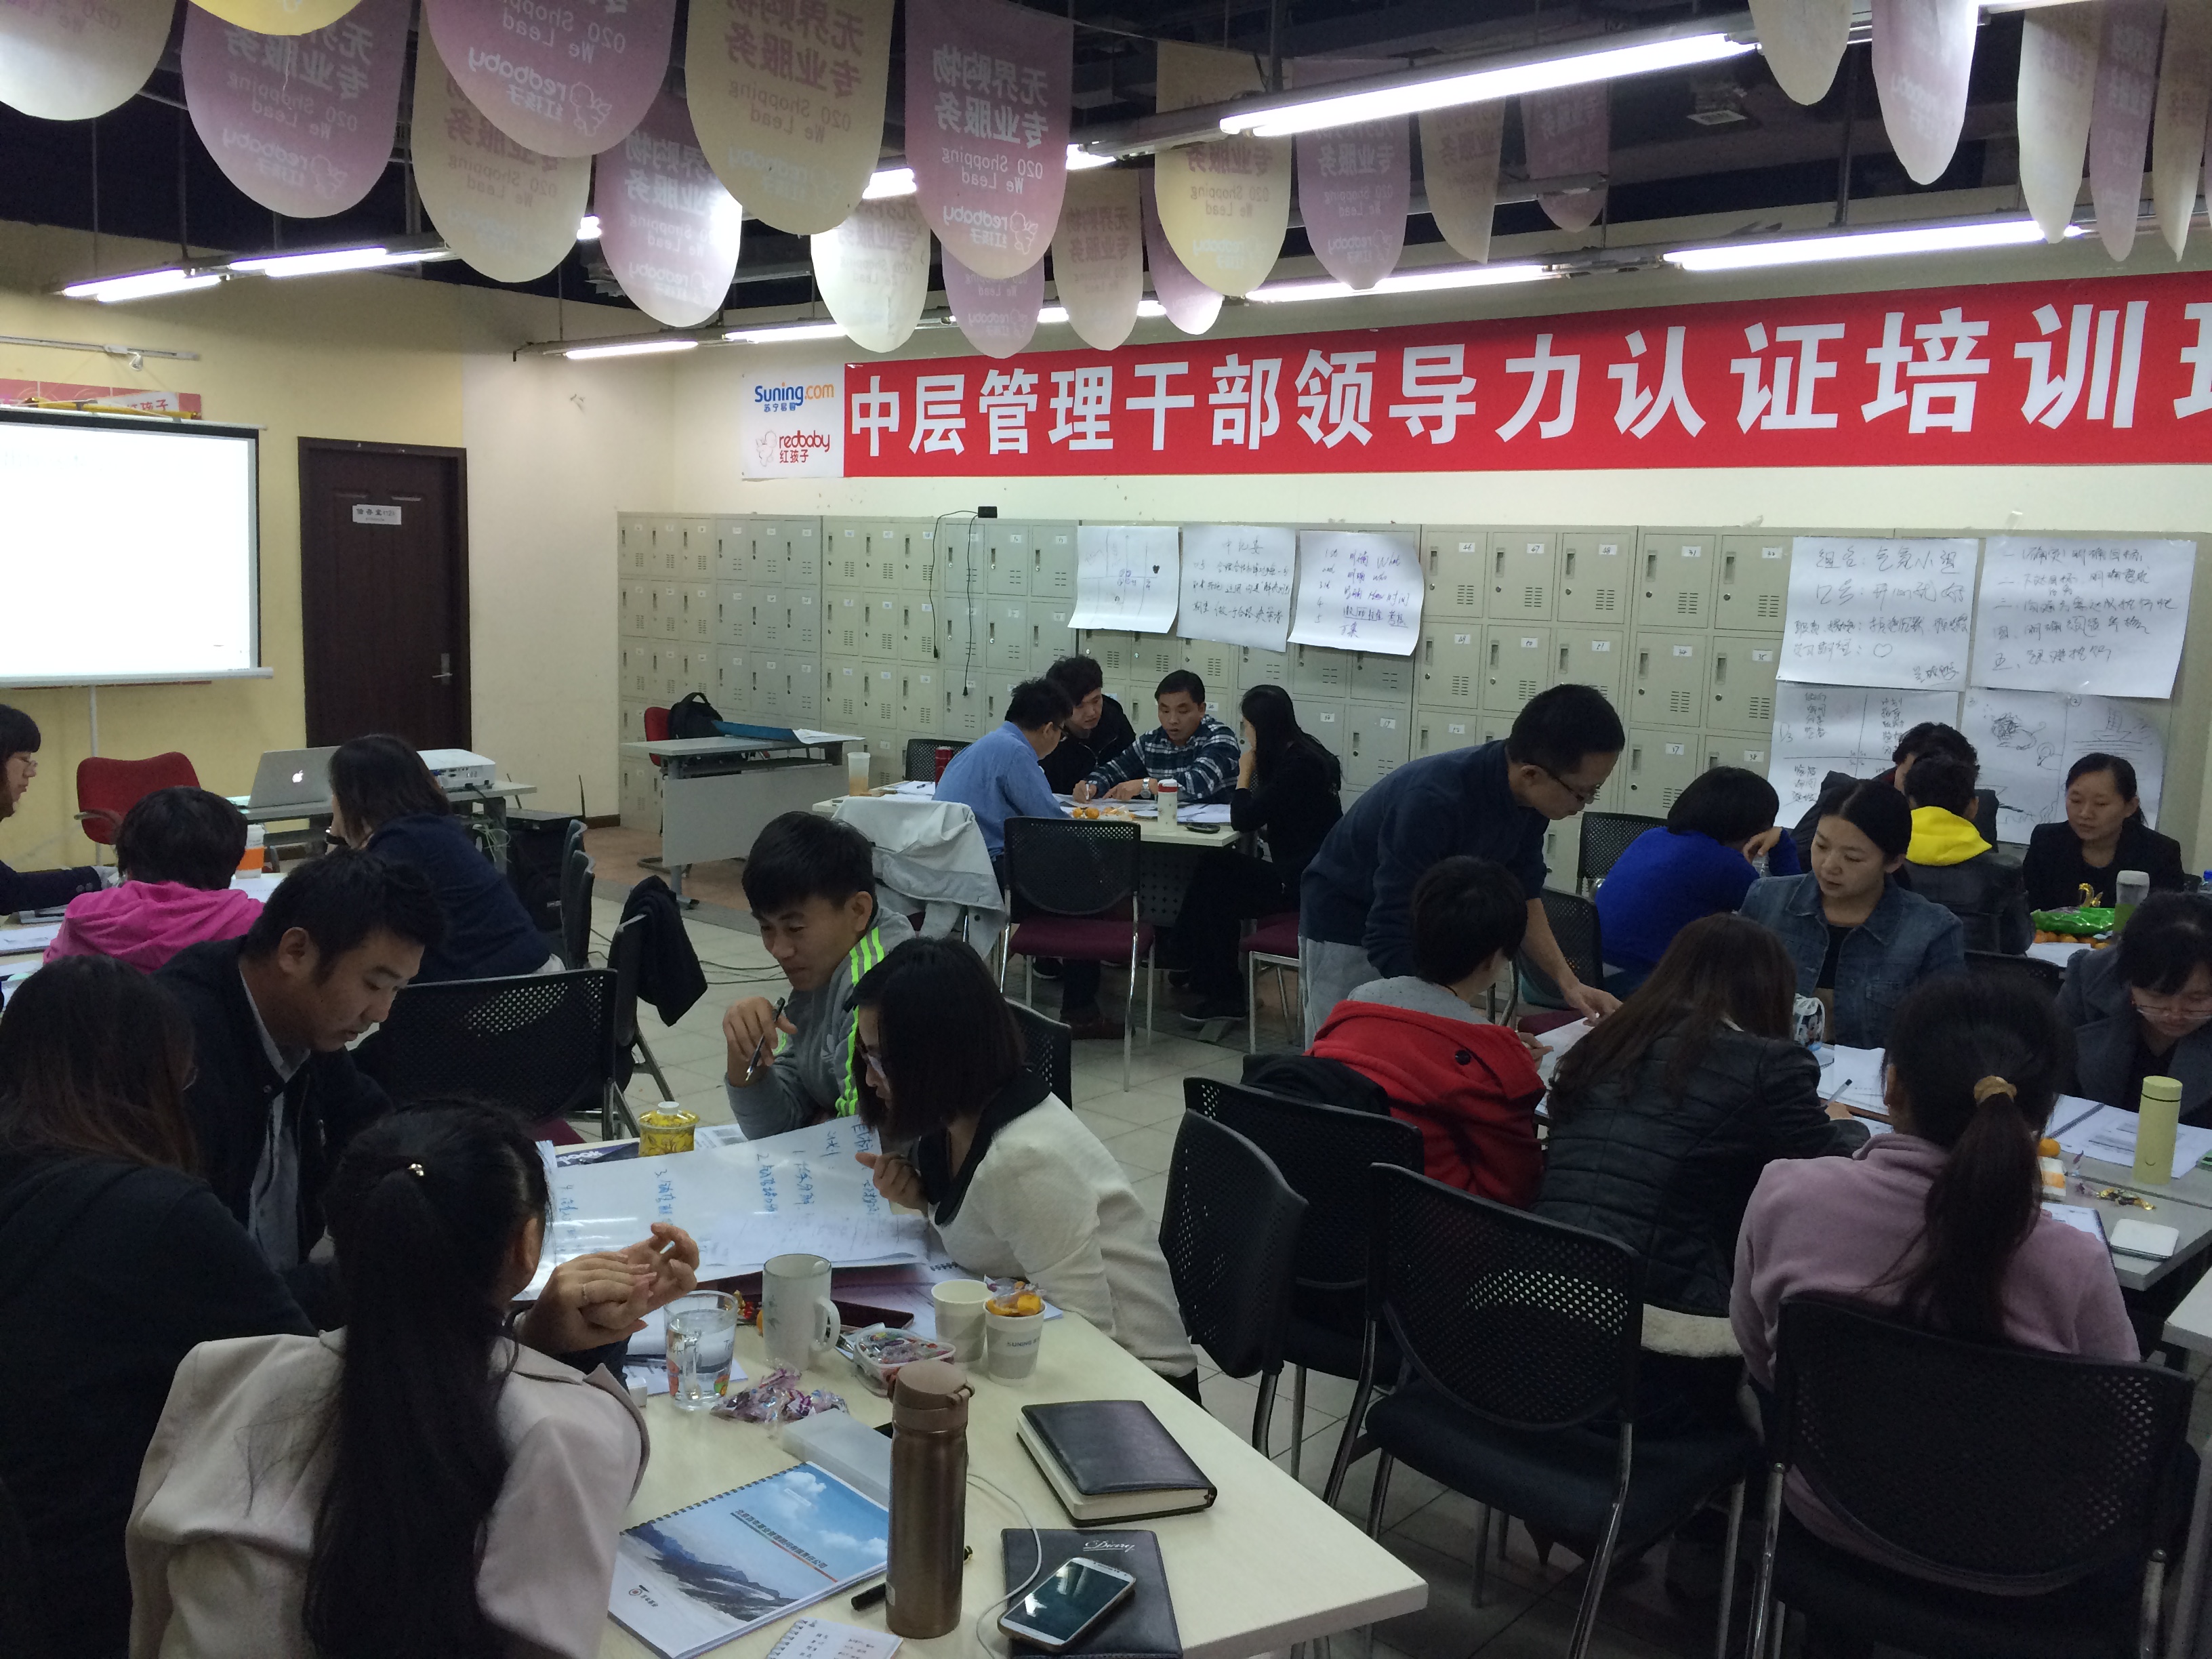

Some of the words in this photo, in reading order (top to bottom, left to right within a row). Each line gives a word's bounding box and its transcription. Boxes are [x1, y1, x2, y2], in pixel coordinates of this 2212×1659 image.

[754, 382, 835, 406] Suning.com
[779, 430, 830, 453] redbaby
[779, 449, 808, 463] 红孩子
